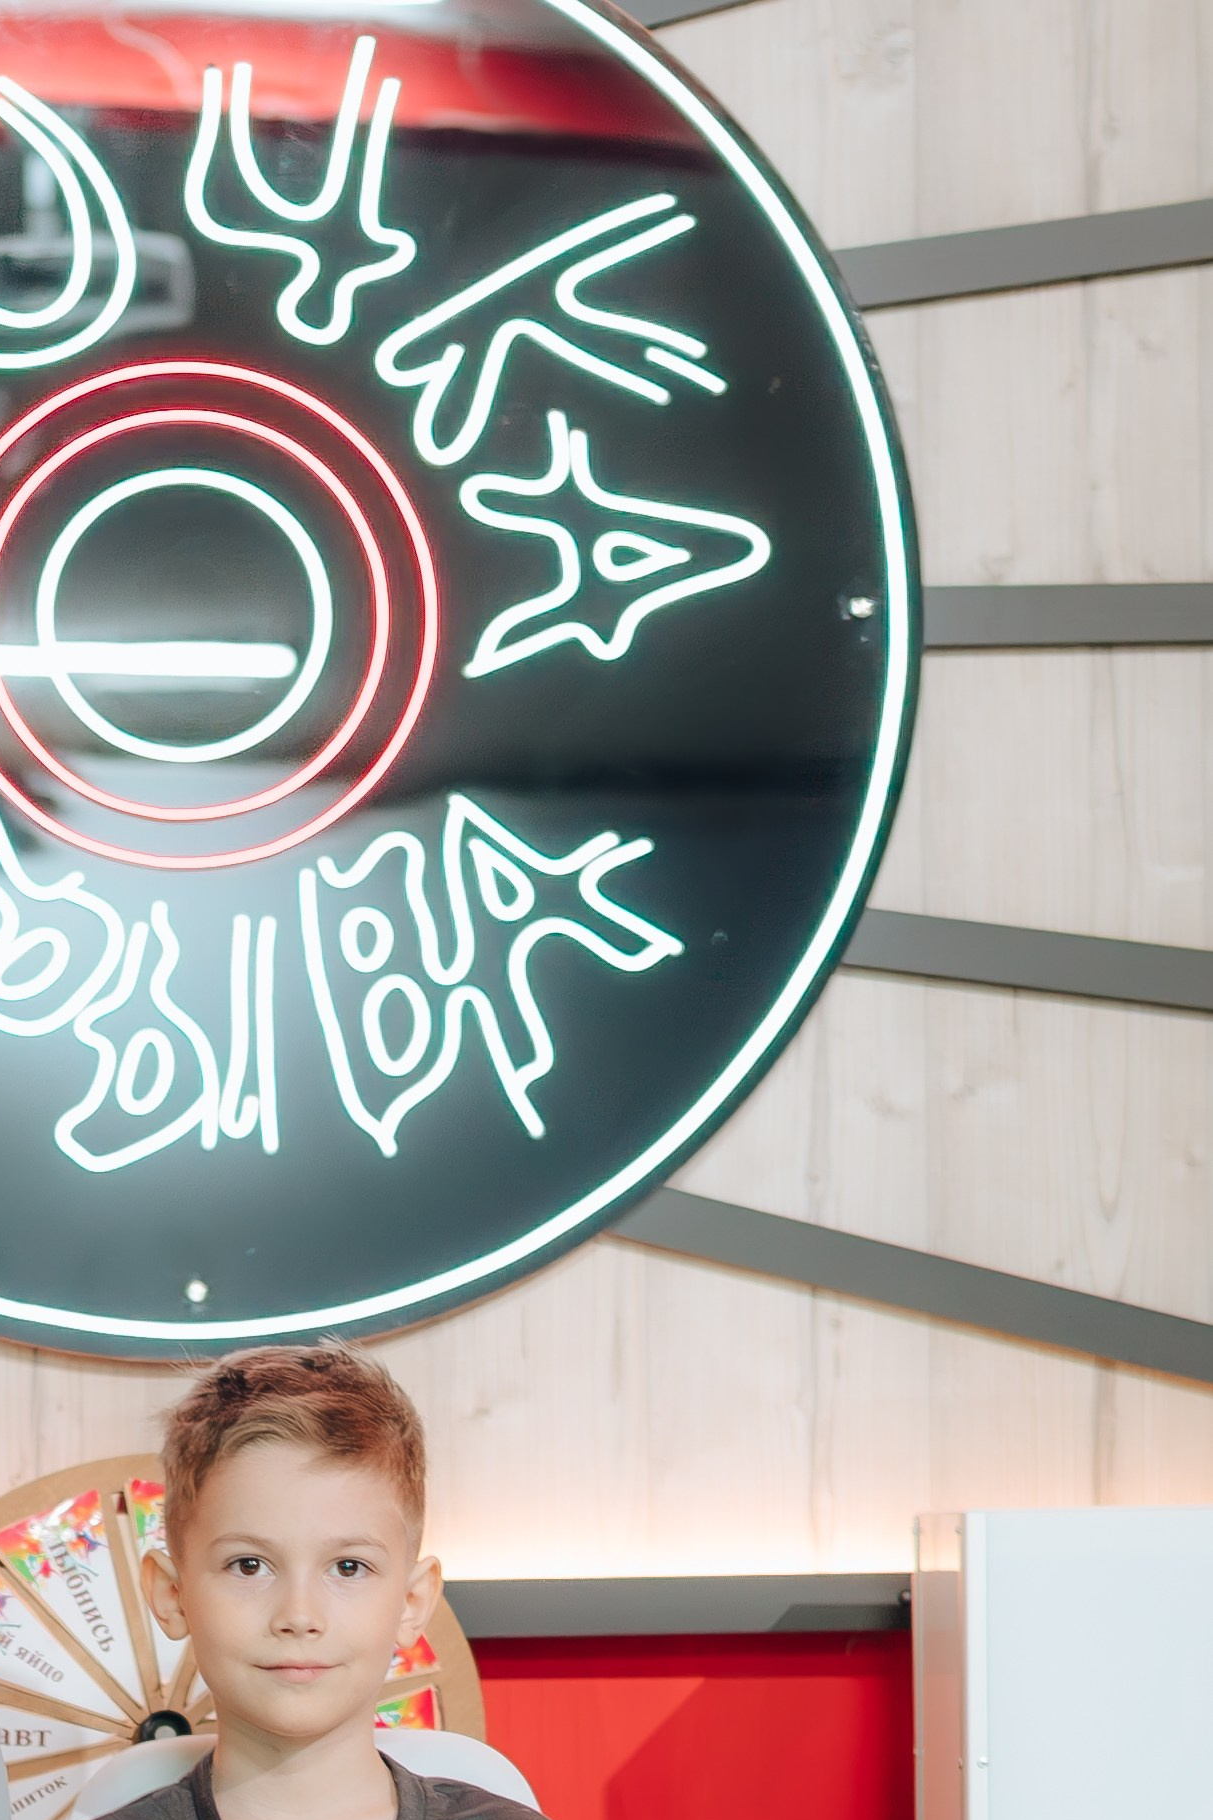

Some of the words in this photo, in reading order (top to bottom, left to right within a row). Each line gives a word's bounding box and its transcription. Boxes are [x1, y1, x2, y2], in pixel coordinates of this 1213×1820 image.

[42, 1526, 115, 1653] лыбнись
[14, 1645, 65, 1683] яйцо
[10, 1775, 69, 1815] питок
